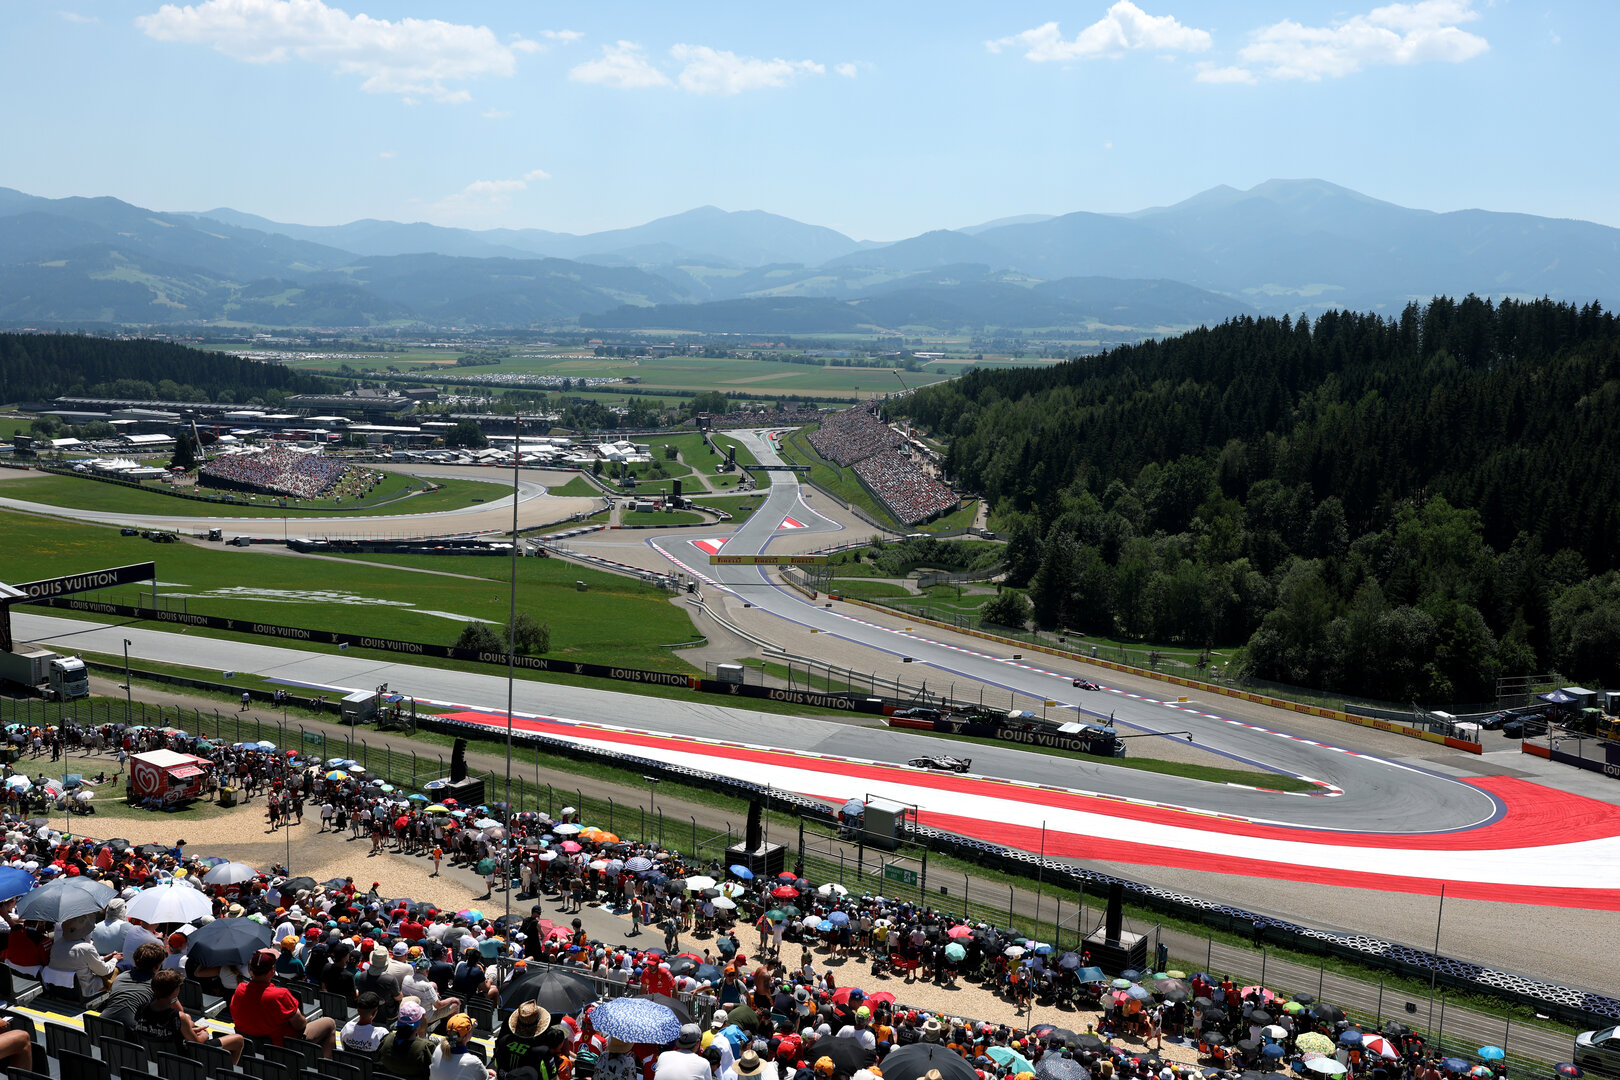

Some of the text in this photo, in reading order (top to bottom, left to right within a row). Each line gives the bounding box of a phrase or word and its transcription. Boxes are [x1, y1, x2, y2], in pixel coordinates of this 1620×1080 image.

[23, 571, 118, 599] LOUIS VUITTON
[70, 601, 116, 613] LOUIS VUITTON
[157, 611, 208, 625] LOUIS VUITTON
[253, 624, 310, 639] LOUIS VUITTON
[361, 637, 385, 649] LOUIS
[387, 640, 423, 653] VUITTON
[479, 651, 507, 664] LOUIS
[610, 668, 688, 686] LOUIS VUITTON
[770, 689, 855, 710] LOUIS VUITTON
[997, 728, 1091, 751] LOUIS VUITTON
[506, 1041, 531, 1055] 46
